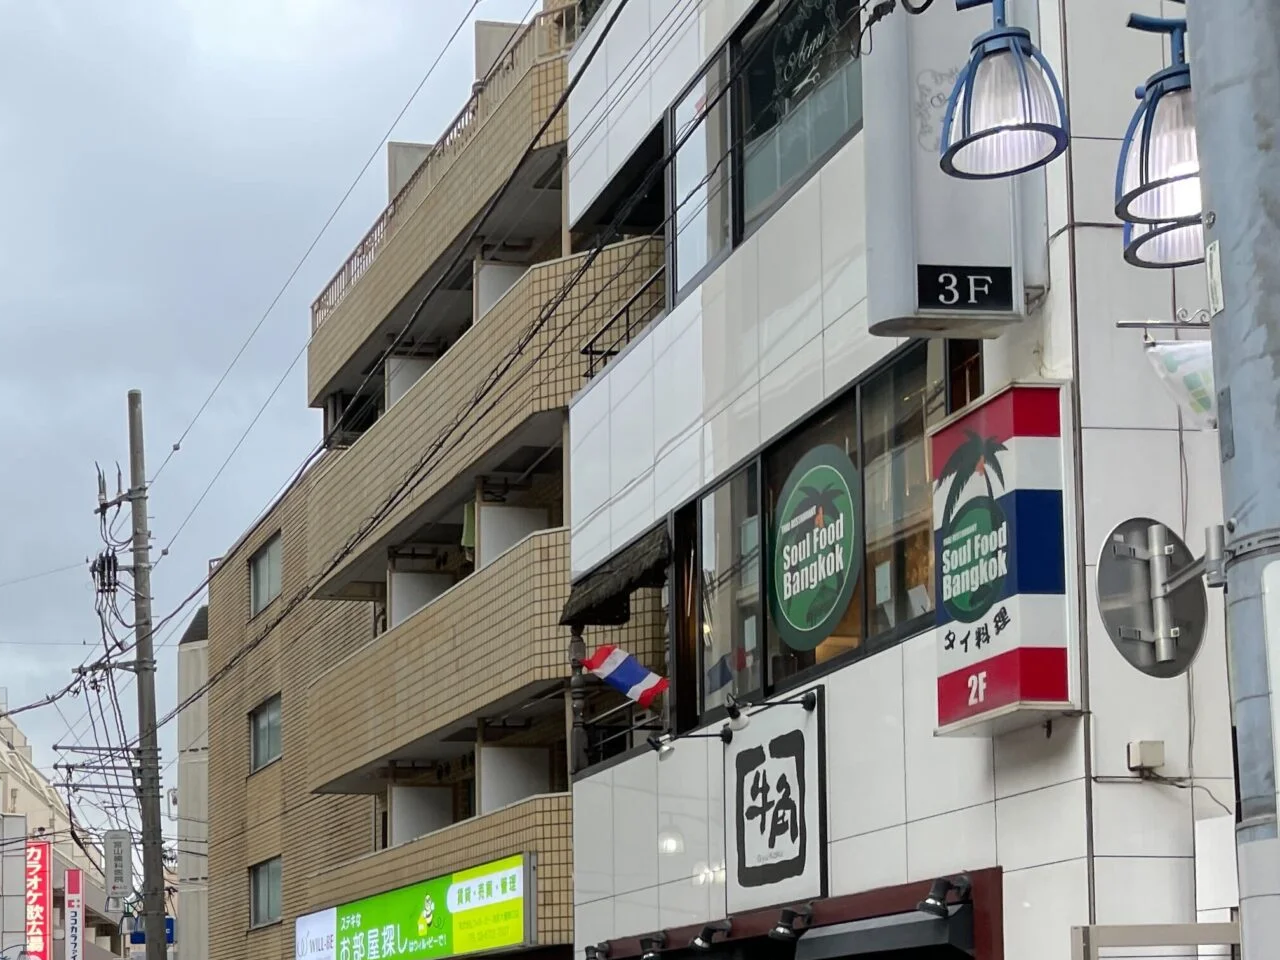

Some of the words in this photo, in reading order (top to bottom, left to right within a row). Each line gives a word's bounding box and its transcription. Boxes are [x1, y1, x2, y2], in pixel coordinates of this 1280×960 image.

[937, 272, 993, 305] 3F
[782, 532, 811, 571] Soul
[813, 512, 844, 554] Food
[942, 538, 972, 574] Soul
[974, 520, 1007, 560] Food
[783, 543, 844, 601] Bangkok
[942, 548, 1008, 602] Bangkok
[944, 605, 1011, 653] タイ料理
[967, 671, 988, 706] 2F
[745, 769, 799, 849] 牛角
[340, 914, 362, 932] ステキな
